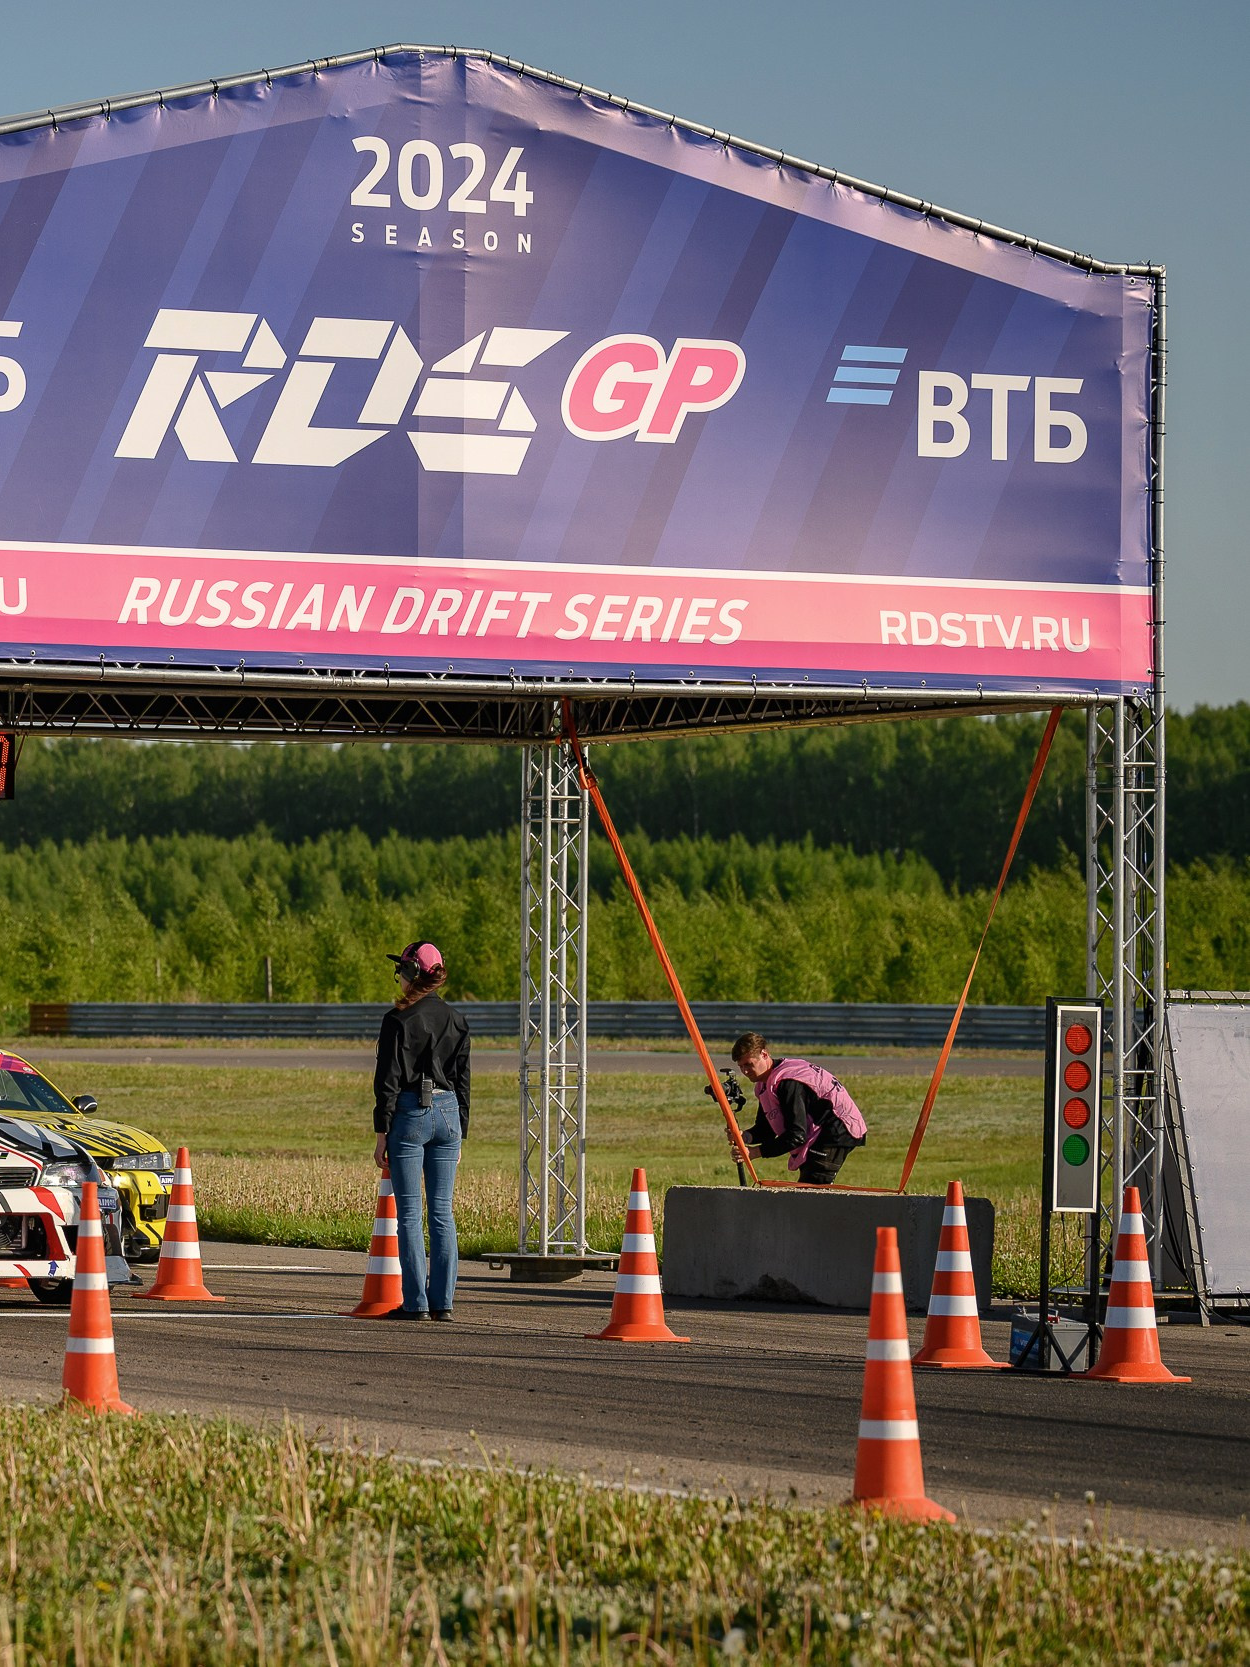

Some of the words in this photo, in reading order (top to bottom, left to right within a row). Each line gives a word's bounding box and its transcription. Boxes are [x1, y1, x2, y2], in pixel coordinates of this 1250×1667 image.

[351, 136, 534, 217] 2024
[351, 222, 532, 254] SEASON
[113, 308, 572, 475] RDS
[561, 333, 746, 443] GP
[917, 370, 1088, 464] ВТБ
[117, 576, 377, 633] RUSSIAN
[379, 586, 553, 638] DRIFT
[555, 593, 749, 645] SERIES
[879, 610, 1091, 653] RDSTV.RU
